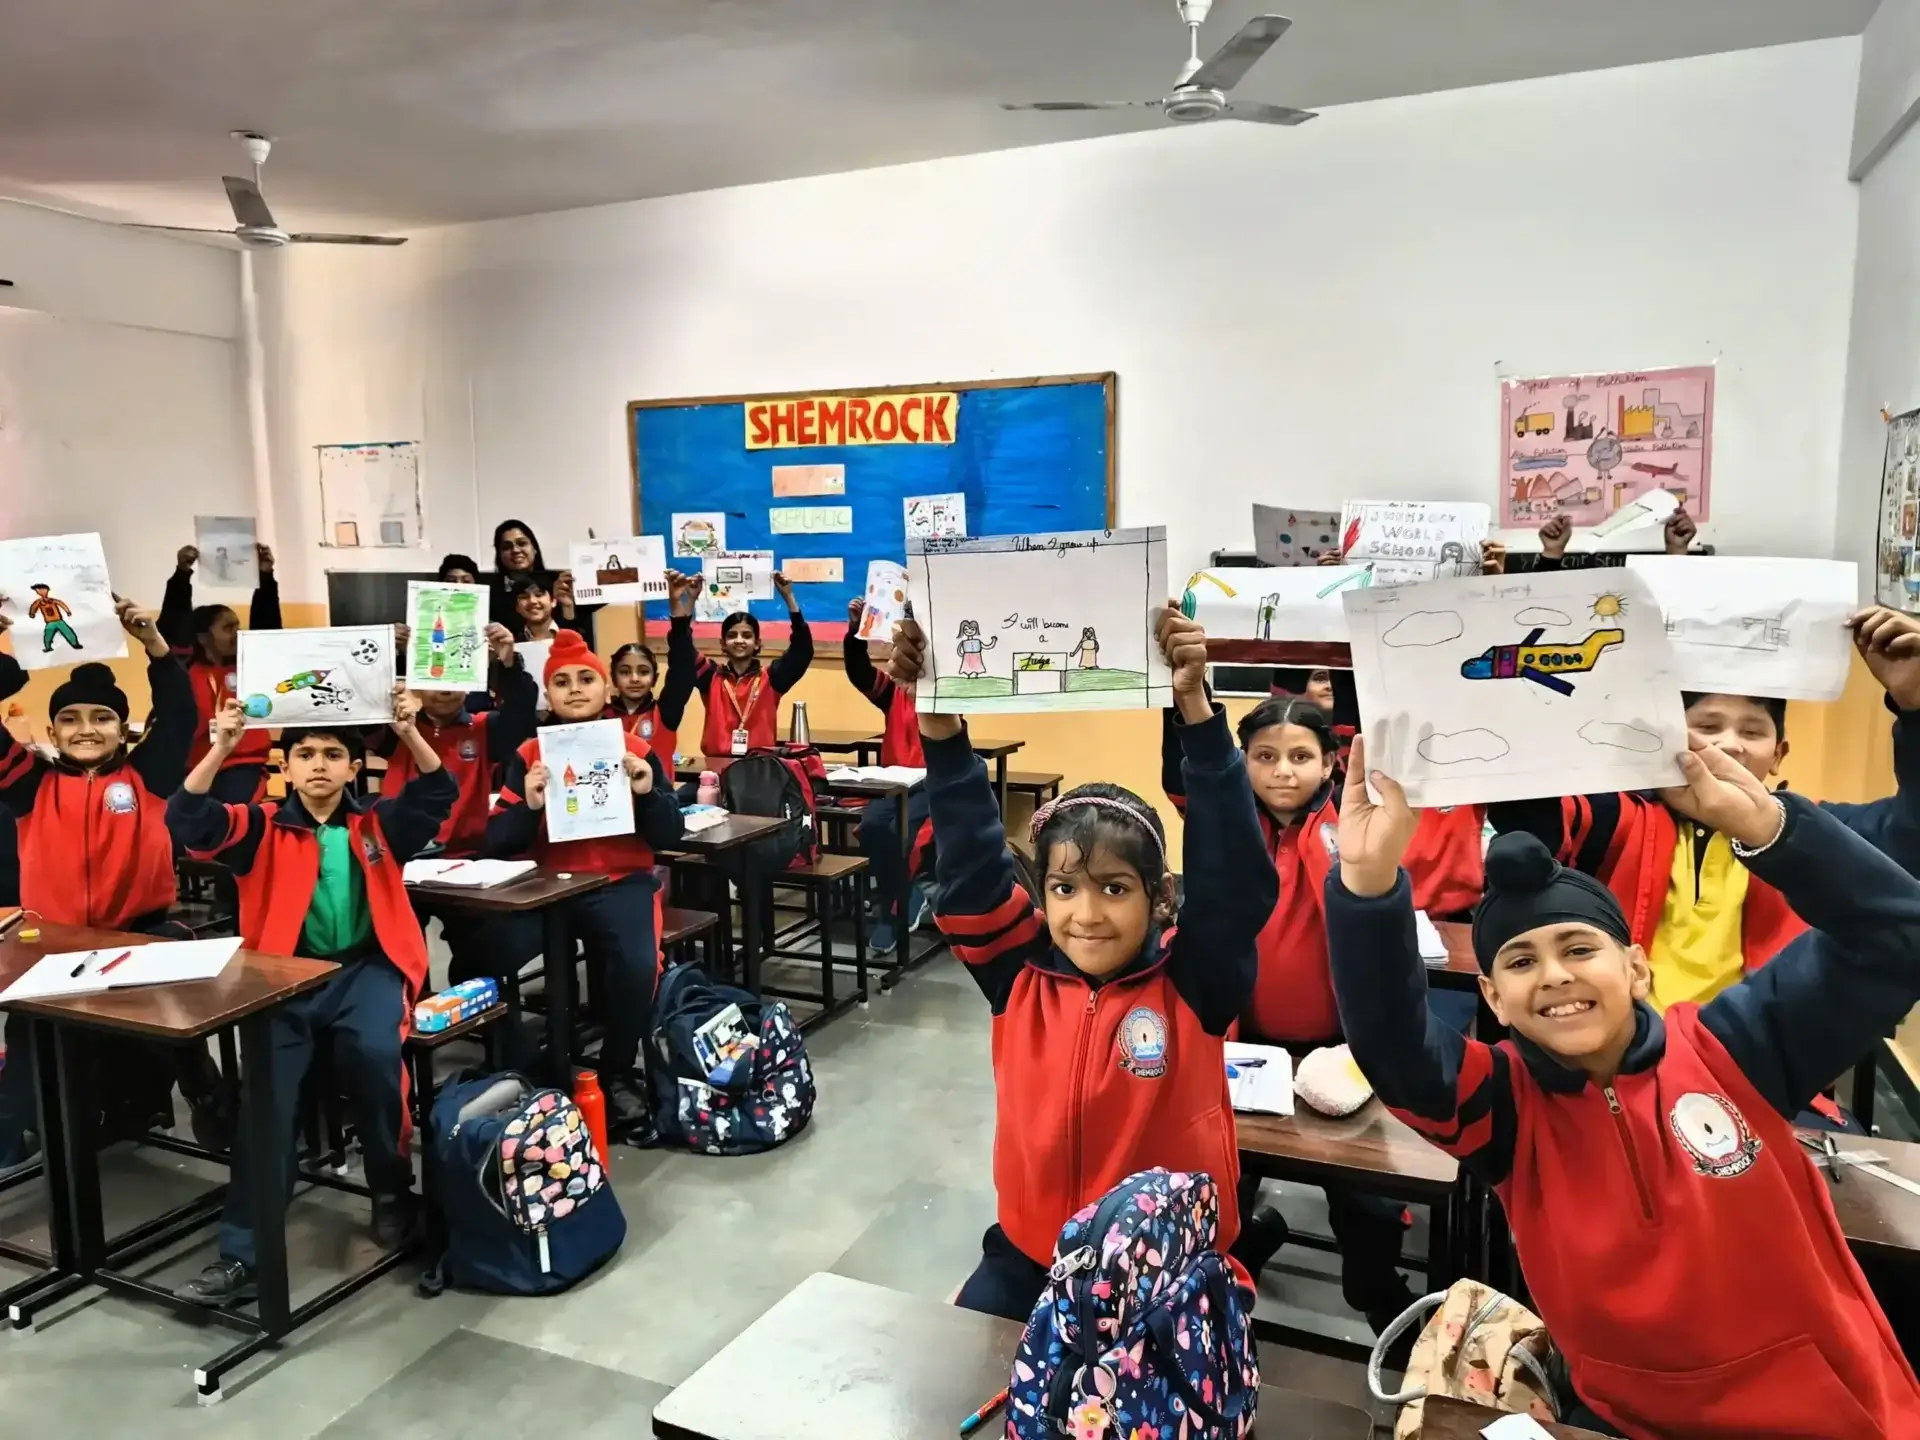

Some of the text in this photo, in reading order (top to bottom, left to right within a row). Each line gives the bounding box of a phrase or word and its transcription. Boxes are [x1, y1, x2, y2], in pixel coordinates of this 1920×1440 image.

[750, 396, 952, 446] SHEMROCK
[1011, 535, 1046, 553] When
[1057, 541, 1084, 560] grow
[1086, 536, 1101, 554] up
[1368, 539, 1437, 558] SCHOOL
[1001, 612, 1019, 630] I
[1020, 617, 1038, 631] will
[1038, 634, 1048, 643] a
[1714, 1154, 1752, 1177] SHEMROCK
